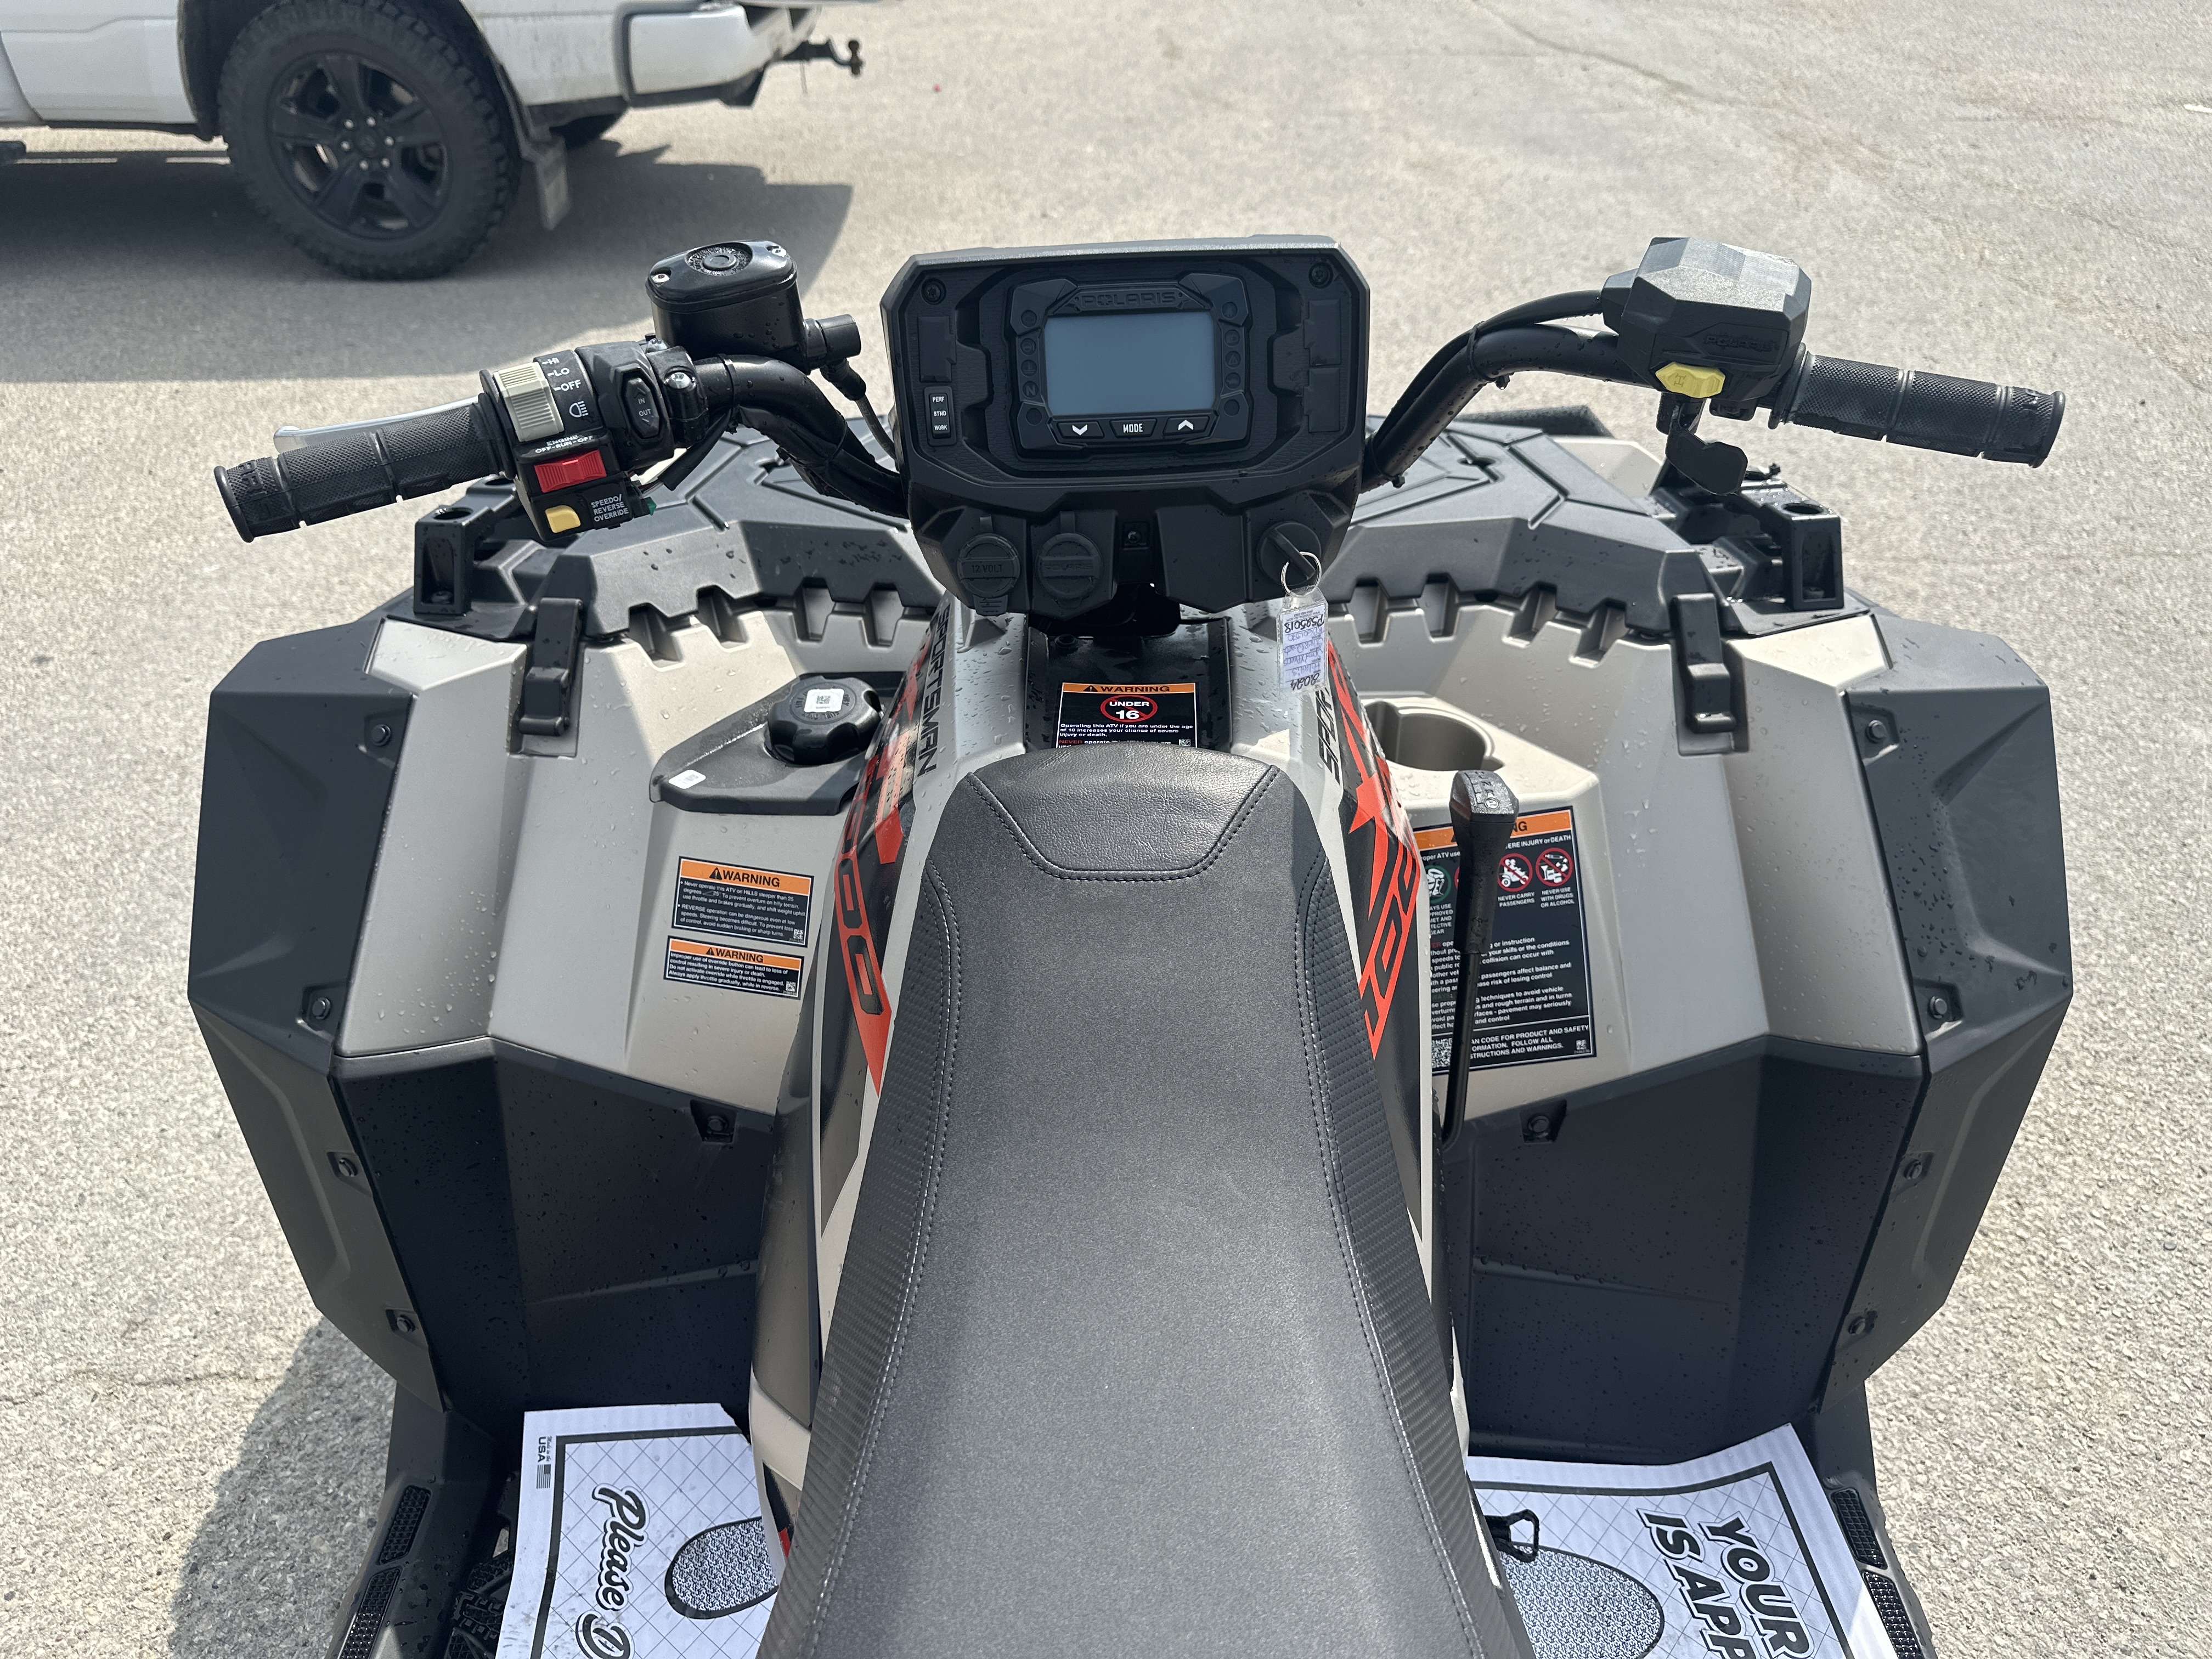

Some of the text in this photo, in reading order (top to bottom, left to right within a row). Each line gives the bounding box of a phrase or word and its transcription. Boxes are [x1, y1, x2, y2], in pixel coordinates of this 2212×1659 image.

[1081, 292, 1177, 308] POLARIS
[639, 408, 651, 417] OUT
[1123, 423, 1143, 433] MODE
[546, 435, 579, 446] ENGINE
[591, 494, 622, 508] SPEEDO/
[593, 501, 625, 515] REVERSE
[594, 507, 629, 522] OVERRIDE
[972, 564, 1003, 573] 12 VOLT
[917, 603, 951, 777] SPORTSMAN
[1115, 710, 1139, 719] 16
[1520, 838, 1543, 847] INJURY
[1550, 834, 1571, 843] DEATH
[722, 870, 780, 887] WARNING
[1499, 898, 1534, 907] PASSENGERS
[1549, 898, 1575, 907] ALCOHOL
[1501, 936, 1534, 946] instruction
[715, 949, 764, 963] WARNING
[1431, 955, 1453, 964] speeds
[1537, 939, 1570, 949] conditions
[1434, 963, 1453, 971] public
[1482, 955, 1508, 964] collision
[1481, 970, 1516, 980] passengers
[1535, 963, 1559, 972] balance
[1511, 975, 1530, 984] losing
[1530, 972, 1553, 980] control
[1481, 991, 1515, 1002] techniques
[1541, 985, 1564, 994] vehicle
[1494, 1000, 1513, 1008] rough
[1498, 1005, 1528, 1014] pavement
[1543, 999, 1571, 1009] seriously
[1480, 1035, 1499, 1043] CODE
[1515, 1030, 1547, 1039] PRODUCT
[1564, 1024, 1589, 1034] SAFETY
[1471, 1042, 1508, 1052] ORMATION.
[1511, 1038, 1539, 1047] FOLLOW
[1526, 1042, 1563, 1053] WARNINGS.
[538, 1437, 546, 1463] USA
[1641, 1511, 1702, 1559] IS
[594, 1486, 648, 1610] Please
[1703, 1515, 1811, 1656] YOUR
